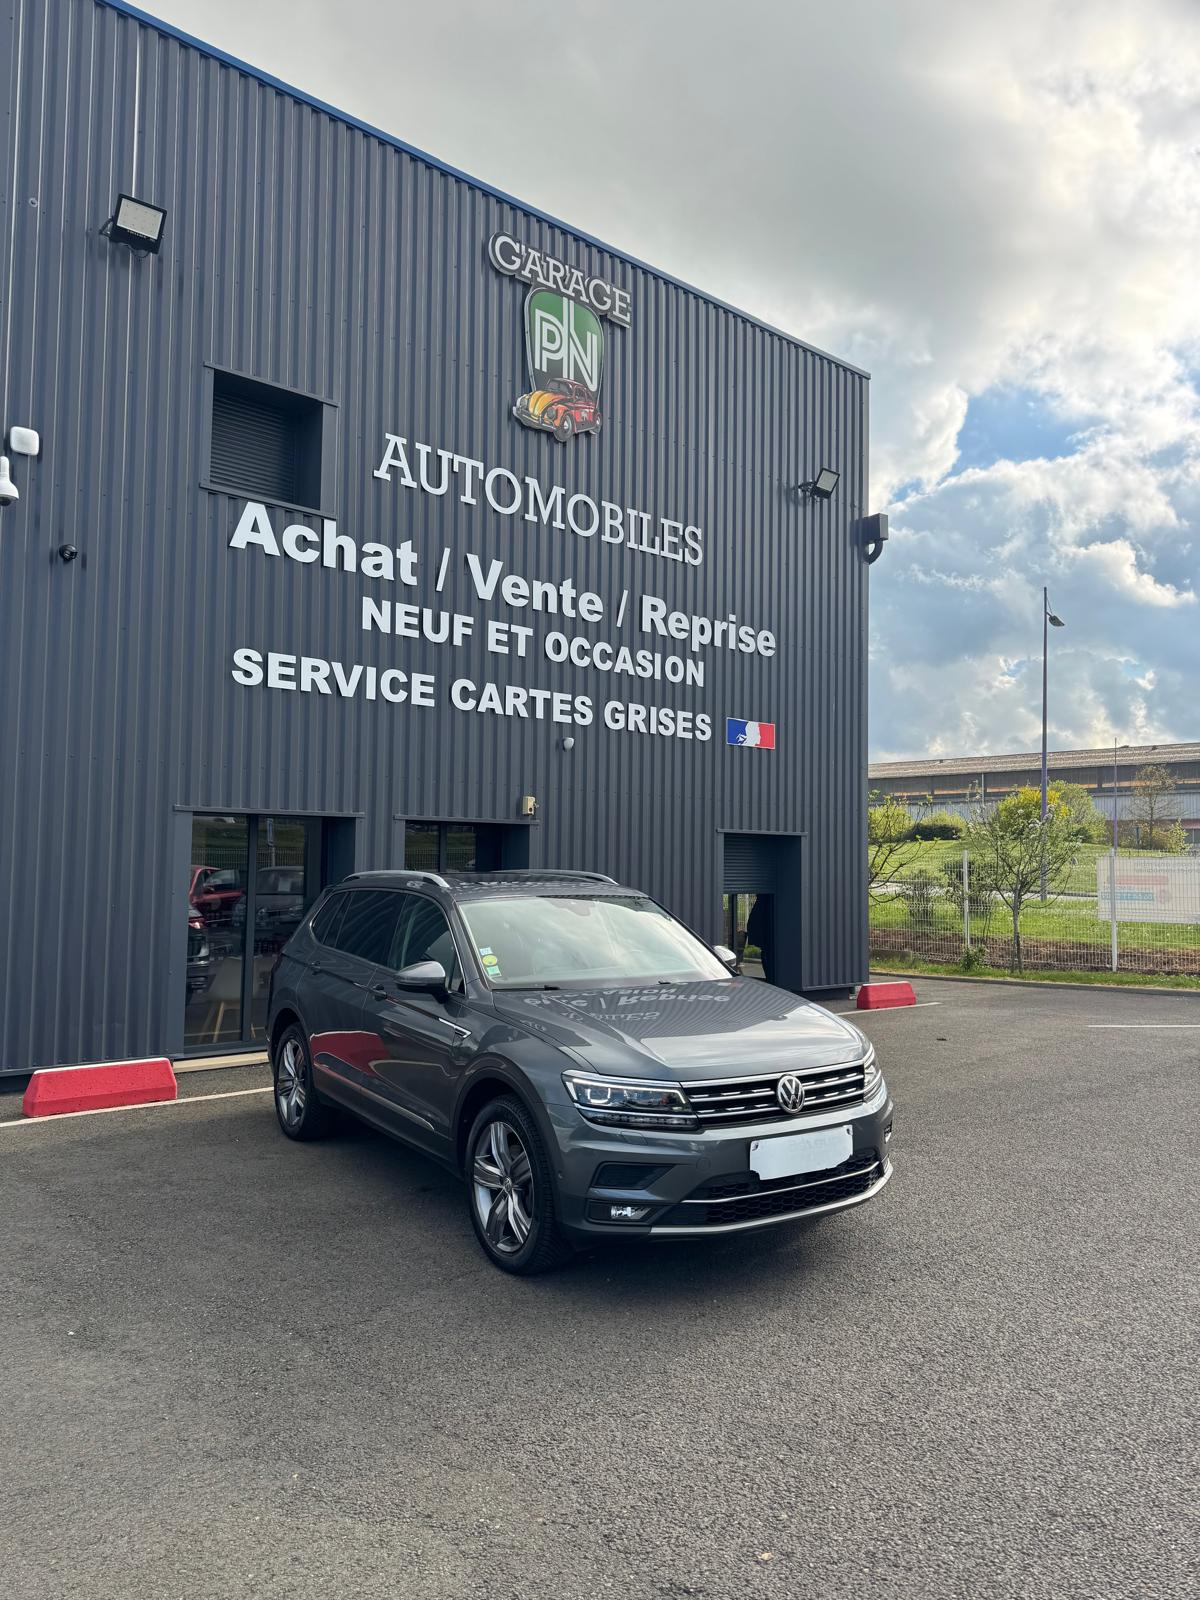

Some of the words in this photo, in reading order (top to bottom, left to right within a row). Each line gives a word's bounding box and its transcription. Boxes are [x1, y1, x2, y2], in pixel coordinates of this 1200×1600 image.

[495, 235, 631, 323] GARAGE
[374, 433, 703, 566] AUTOMOBILES
[230, 502, 418, 586] Achat
[435, 547, 451, 592] /
[466, 553, 604, 623] Vente
[616, 589, 629, 628] /
[643, 594, 776, 657] Reprise
[362, 597, 474, 646] NEUF
[487, 620, 533, 657] ET
[545, 632, 704, 688] OCCASION
[232, 648, 435, 707] SERVICE
[451, 679, 593, 726] CARTES
[604, 700, 712, 741] GRISES
